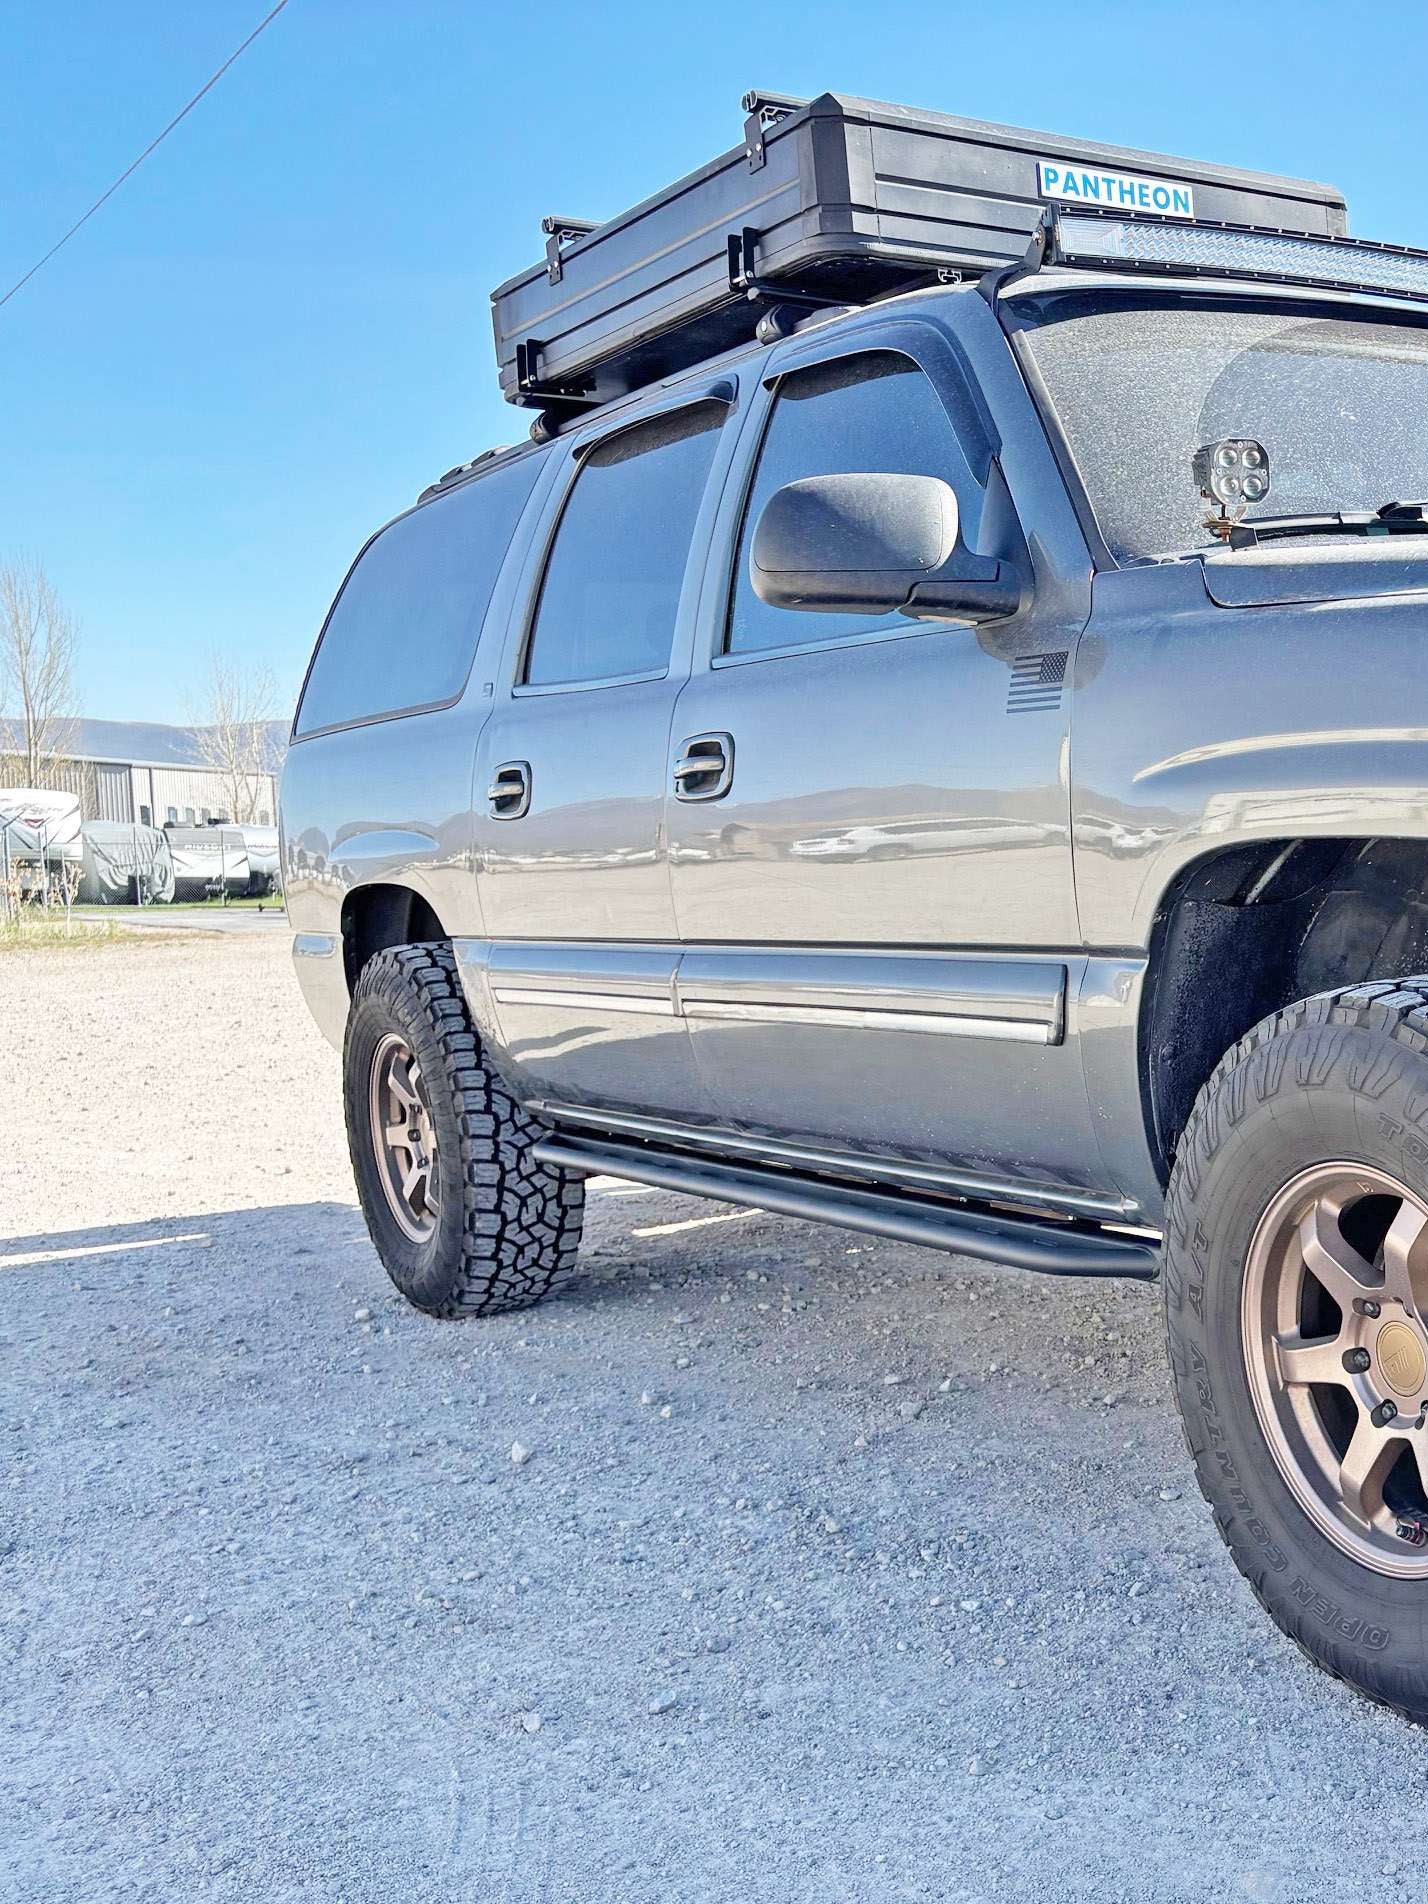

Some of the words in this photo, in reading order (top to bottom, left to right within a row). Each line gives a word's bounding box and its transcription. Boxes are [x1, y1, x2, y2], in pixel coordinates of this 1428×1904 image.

[1043, 167, 1190, 214] PANTHEON
[1188, 1221, 1208, 1324] A/T
[1191, 1342, 1289, 1573] COUNTRY
[1290, 1575, 1391, 1651] OPEN
